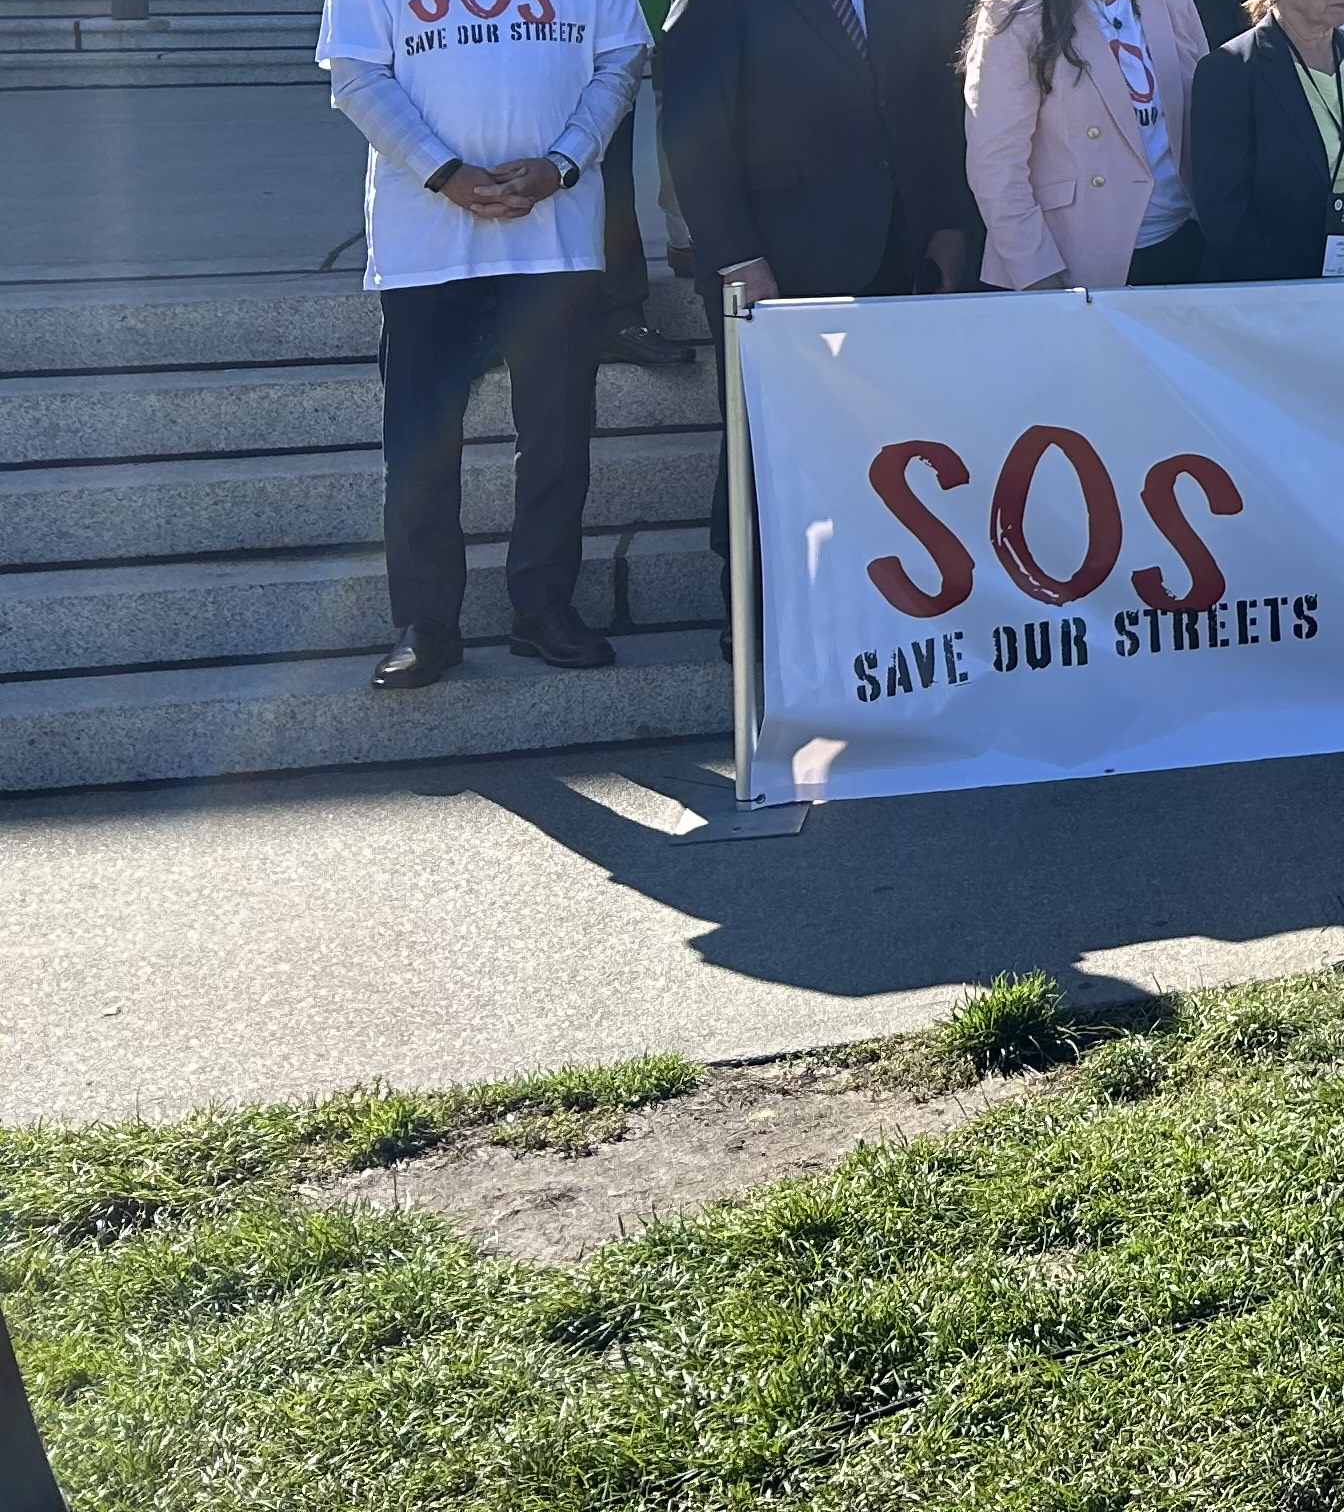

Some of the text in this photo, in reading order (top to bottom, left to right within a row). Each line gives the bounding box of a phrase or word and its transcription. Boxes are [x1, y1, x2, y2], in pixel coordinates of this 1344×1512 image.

[405, 21, 586, 56] SAVE OUR STREETS
[866, 424, 1244, 619] SOS
[854, 593, 1318, 703] SAVE OUR STREETS
